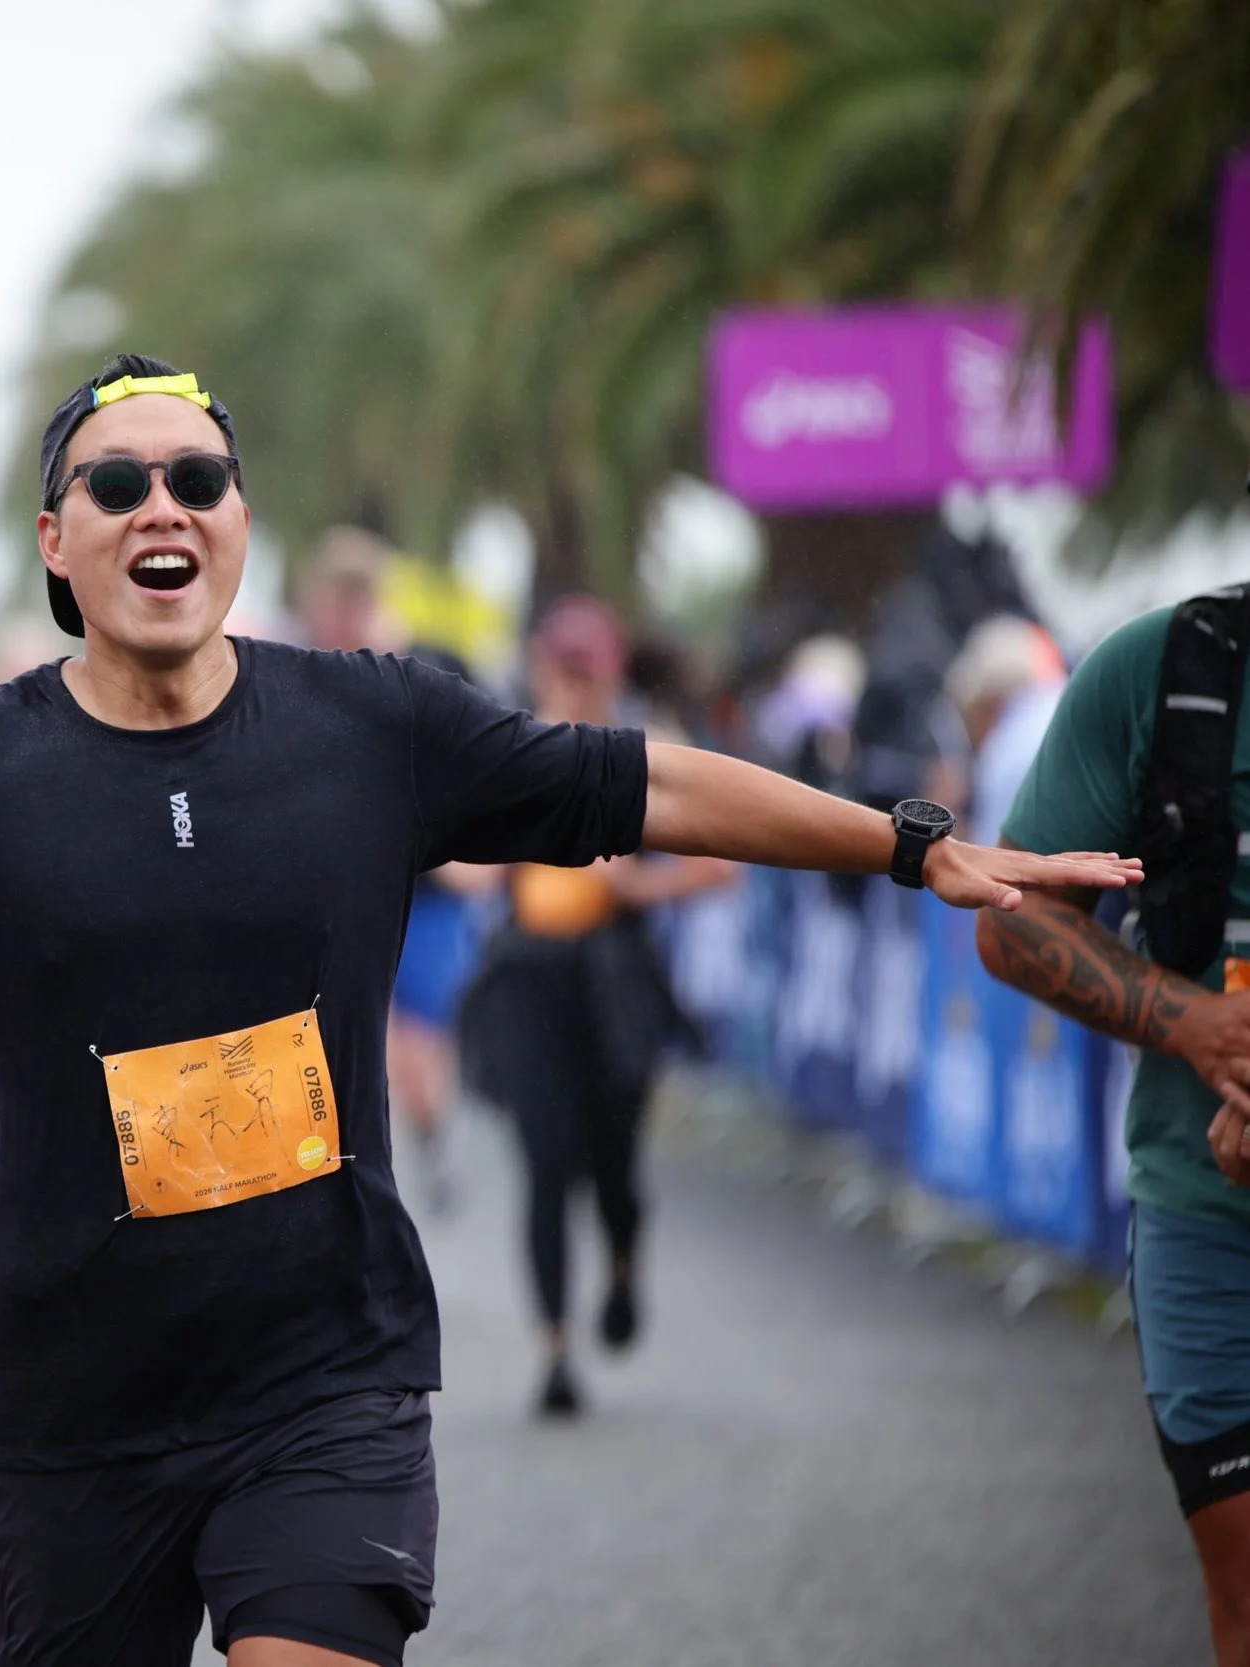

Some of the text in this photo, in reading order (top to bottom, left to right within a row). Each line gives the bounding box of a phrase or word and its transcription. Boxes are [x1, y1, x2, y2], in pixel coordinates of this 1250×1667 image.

[170, 791, 194, 847] HOKA
[303, 1066, 327, 1122] 07886
[116, 1110, 139, 1166] 07886
[234, 1172, 277, 1188] MARATHON
